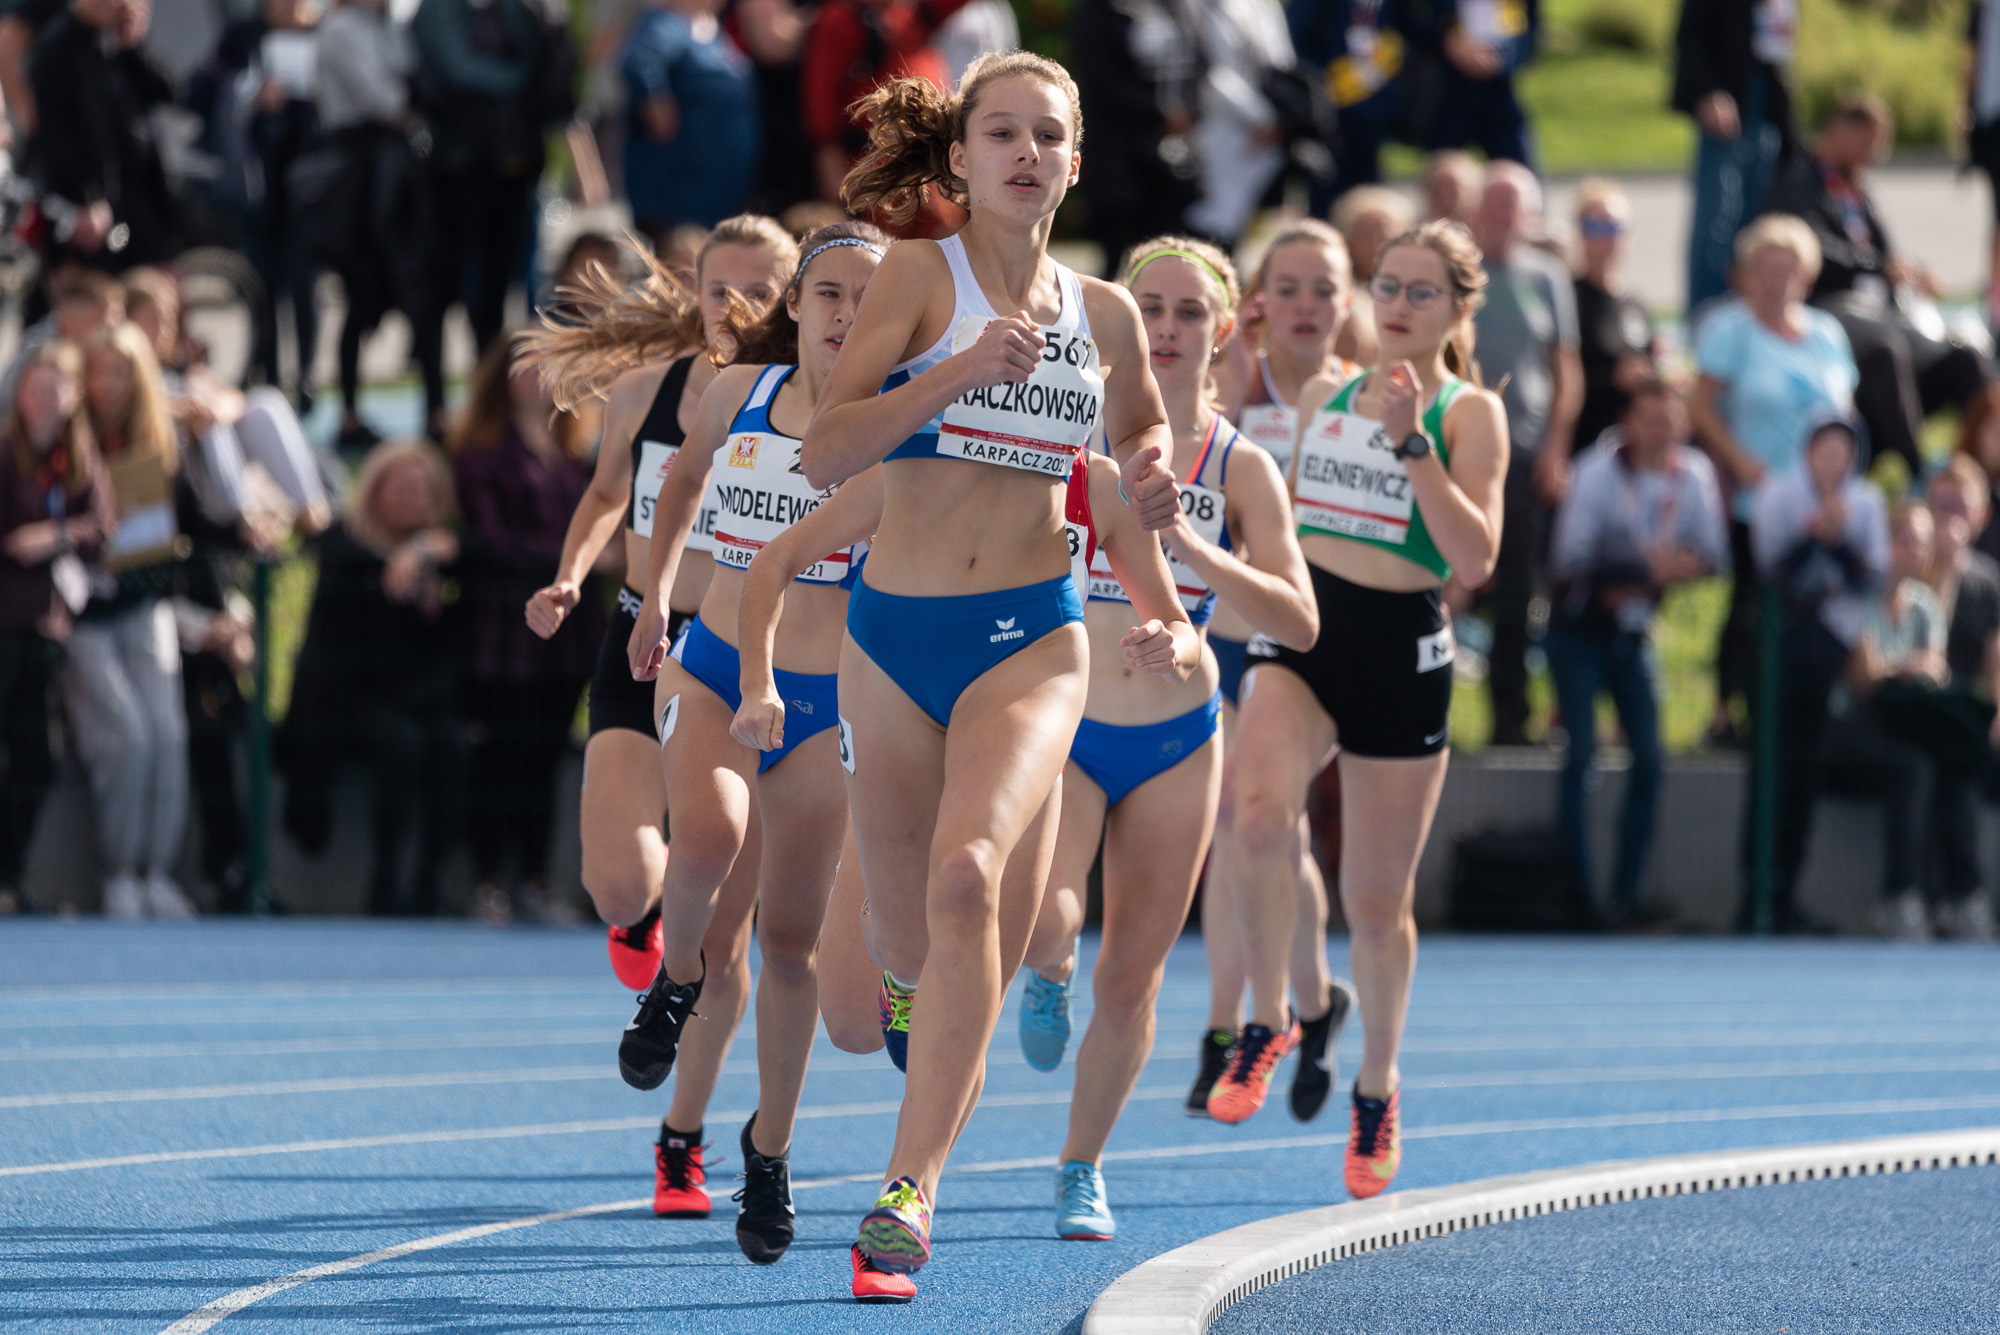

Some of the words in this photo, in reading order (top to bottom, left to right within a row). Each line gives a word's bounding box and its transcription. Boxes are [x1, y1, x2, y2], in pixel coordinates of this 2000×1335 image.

[962, 441, 1042, 468] KARPACZ
[1042, 456, 1068, 473] 202
[716, 484, 826, 526] MODELEW
[989, 629, 1025, 643] erima
